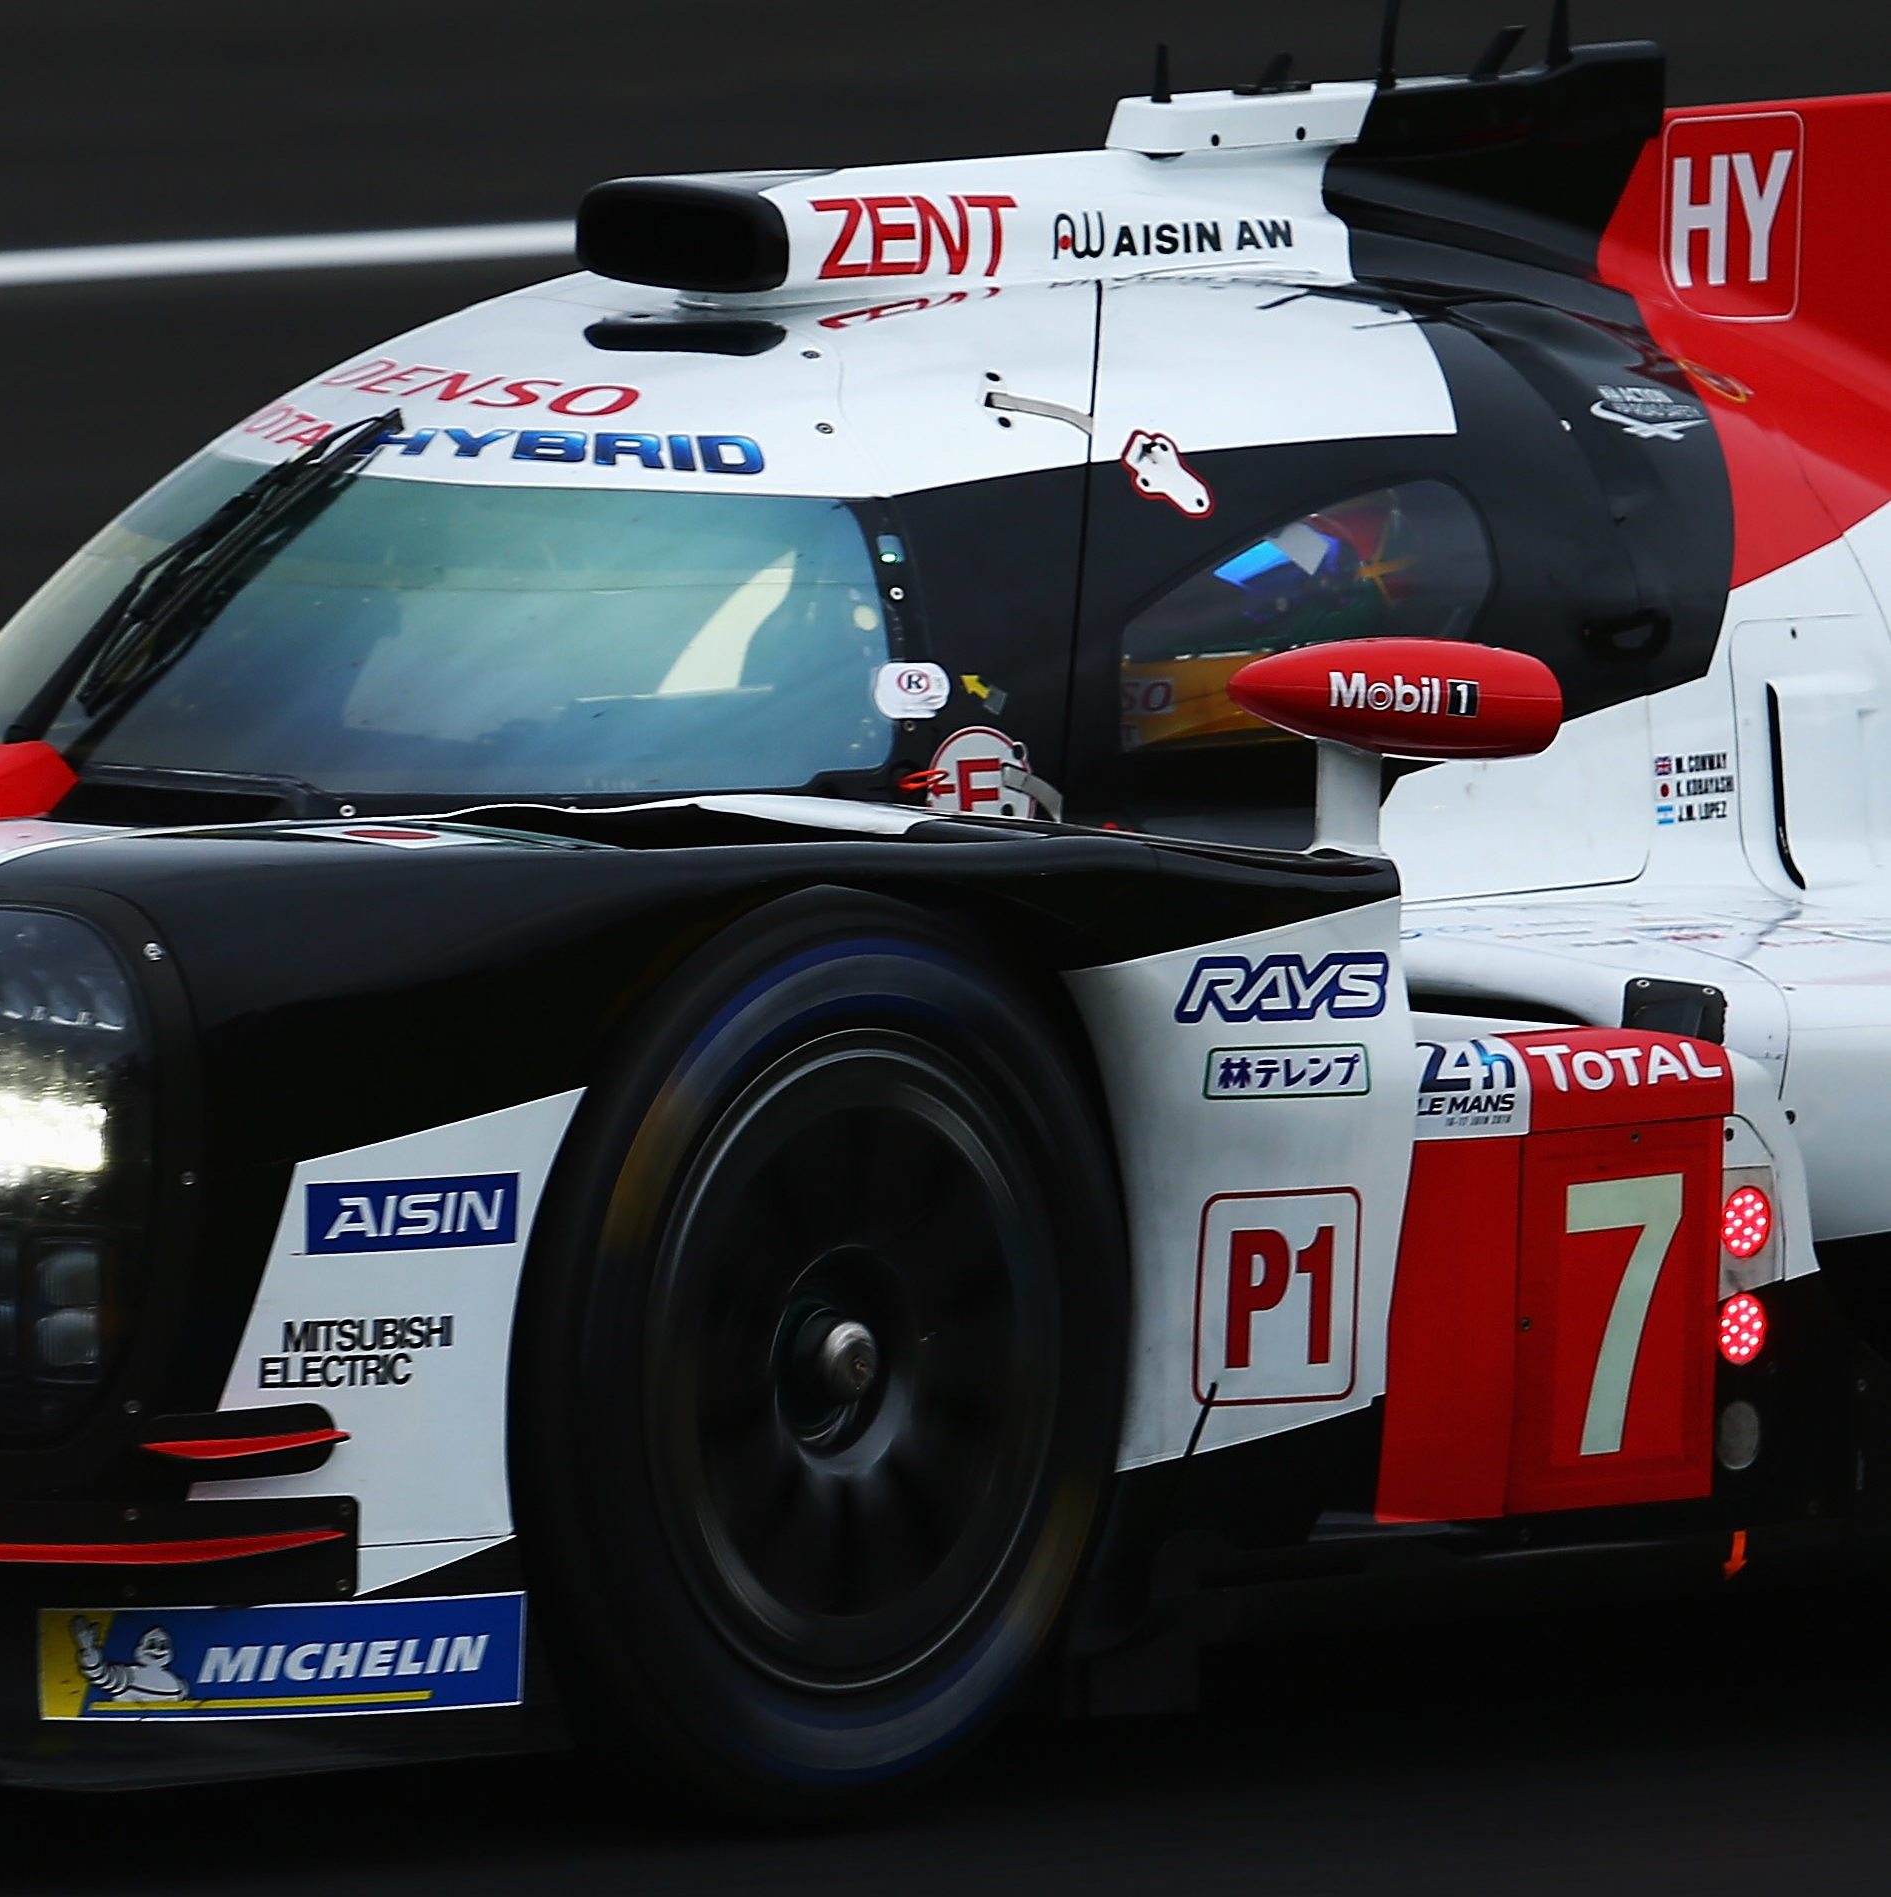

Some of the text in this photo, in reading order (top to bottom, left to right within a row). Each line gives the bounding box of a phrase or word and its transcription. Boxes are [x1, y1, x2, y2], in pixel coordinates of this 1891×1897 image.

[810, 195, 1018, 279] ZENT
[1113, 219, 1294, 257] AISIN AW
[1671, 151, 1793, 286] HY
[323, 359, 641, 416] DENSO
[353, 428, 765, 474] HYBRID
[907, 674, 923, 689] R
[1329, 671, 1469, 714] Mobil 1
[1698, 801, 1727, 820] LOPEZ
[1180, 962, 1387, 1014] RAYS
[1217, 1053, 1360, 1089] 林テレンプ
[1524, 1041, 1724, 1092] TOTAL
[1417, 1094, 1516, 1116] LE MANS
[323, 1188, 505, 1240] AISIN
[1224, 1225, 1336, 1369] P1
[1565, 1172, 1684, 1456] 7
[282, 1314, 454, 1353] MITSUBISHI
[258, 1353, 413, 1389] ELECTRIC
[197, 1634, 490, 1684] MICHELIN
